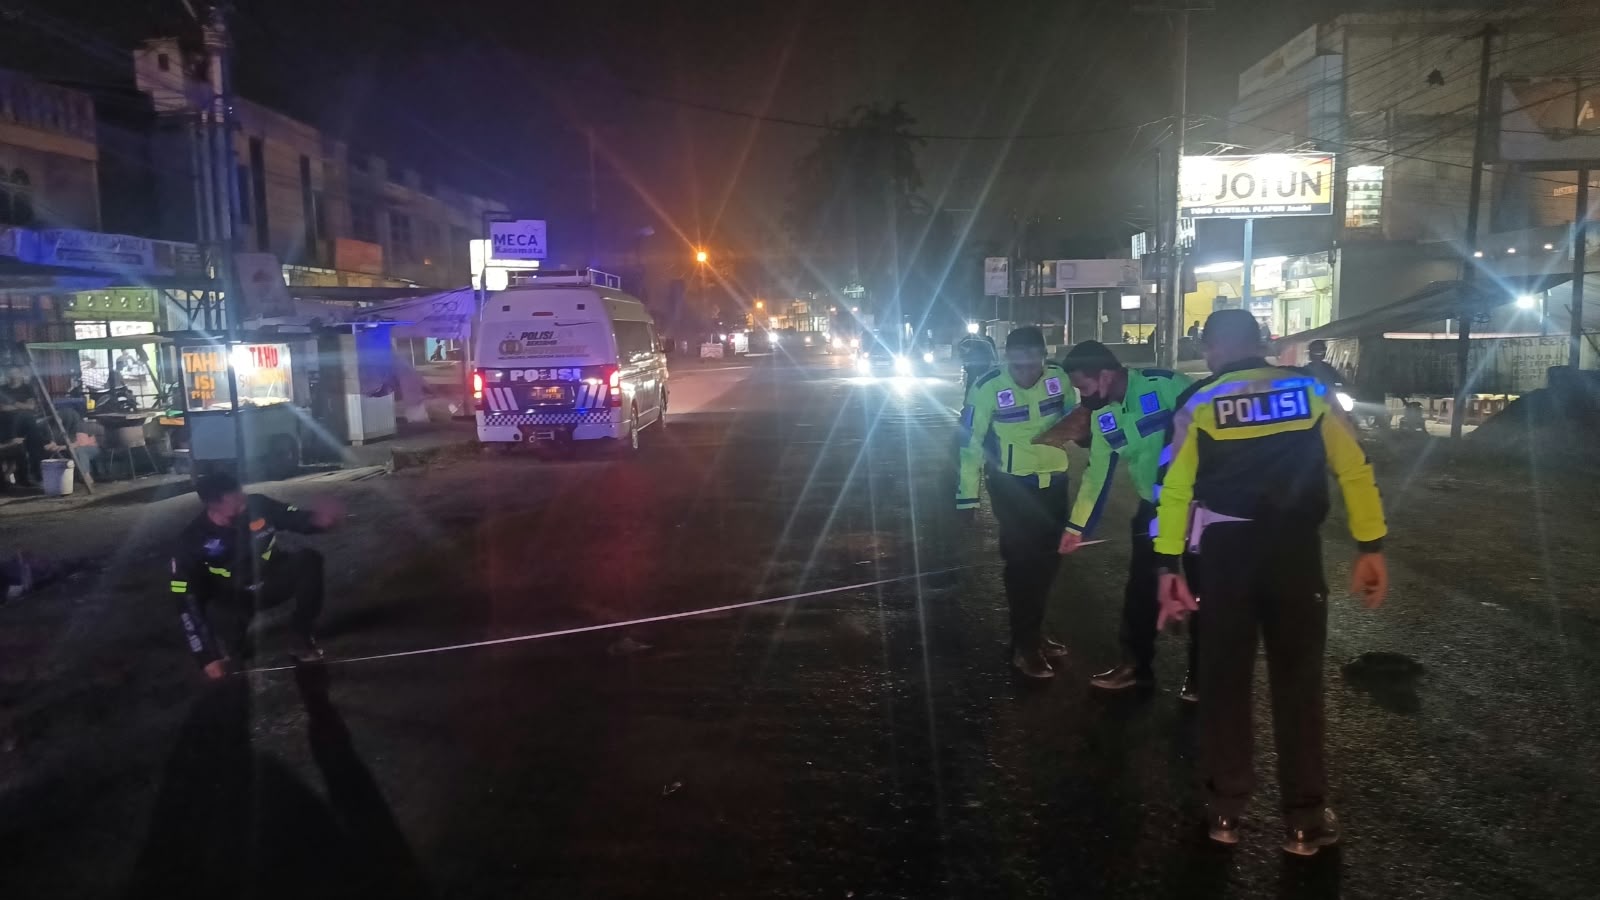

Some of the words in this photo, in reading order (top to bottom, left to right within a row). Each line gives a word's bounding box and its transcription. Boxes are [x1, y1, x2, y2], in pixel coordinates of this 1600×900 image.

[494, 233, 537, 246] MECA
[520, 331, 554, 341] POLISI
[249, 347, 278, 368] TAHU
[510, 368, 581, 382] POLISI
[1216, 390, 1308, 425] POLISI
